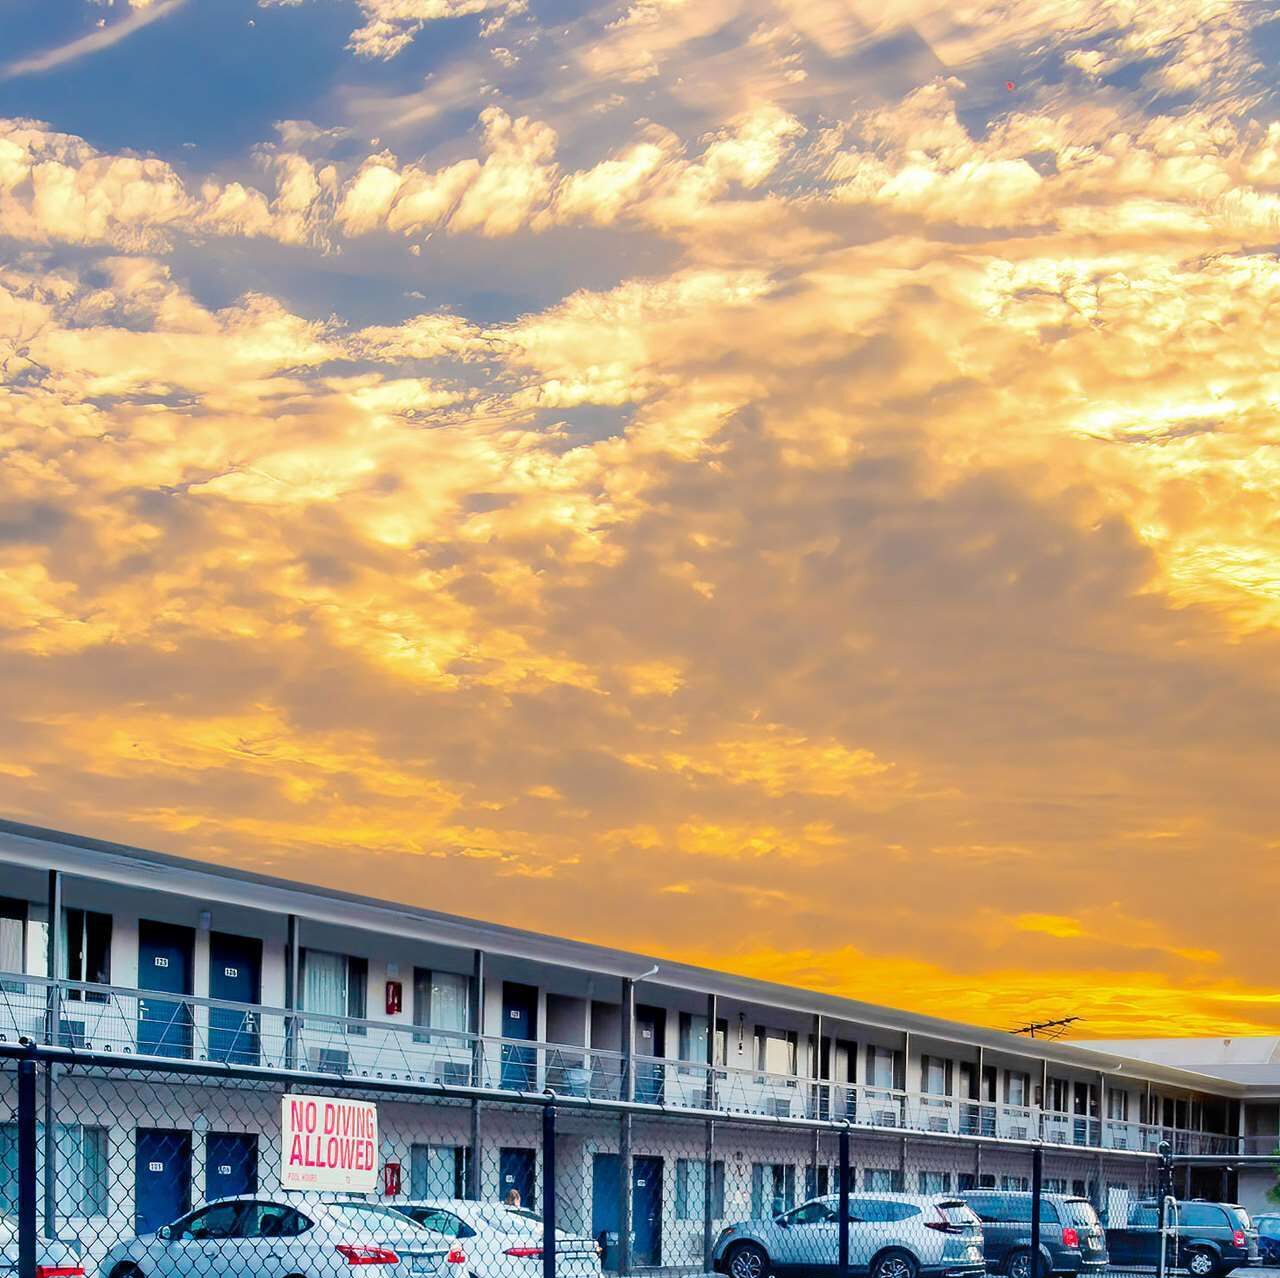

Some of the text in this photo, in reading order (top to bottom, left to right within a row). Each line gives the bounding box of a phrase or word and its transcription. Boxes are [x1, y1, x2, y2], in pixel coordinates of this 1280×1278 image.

[291, 1100, 374, 1139] NO DIVING
[289, 1134, 375, 1171] ALLOWED
